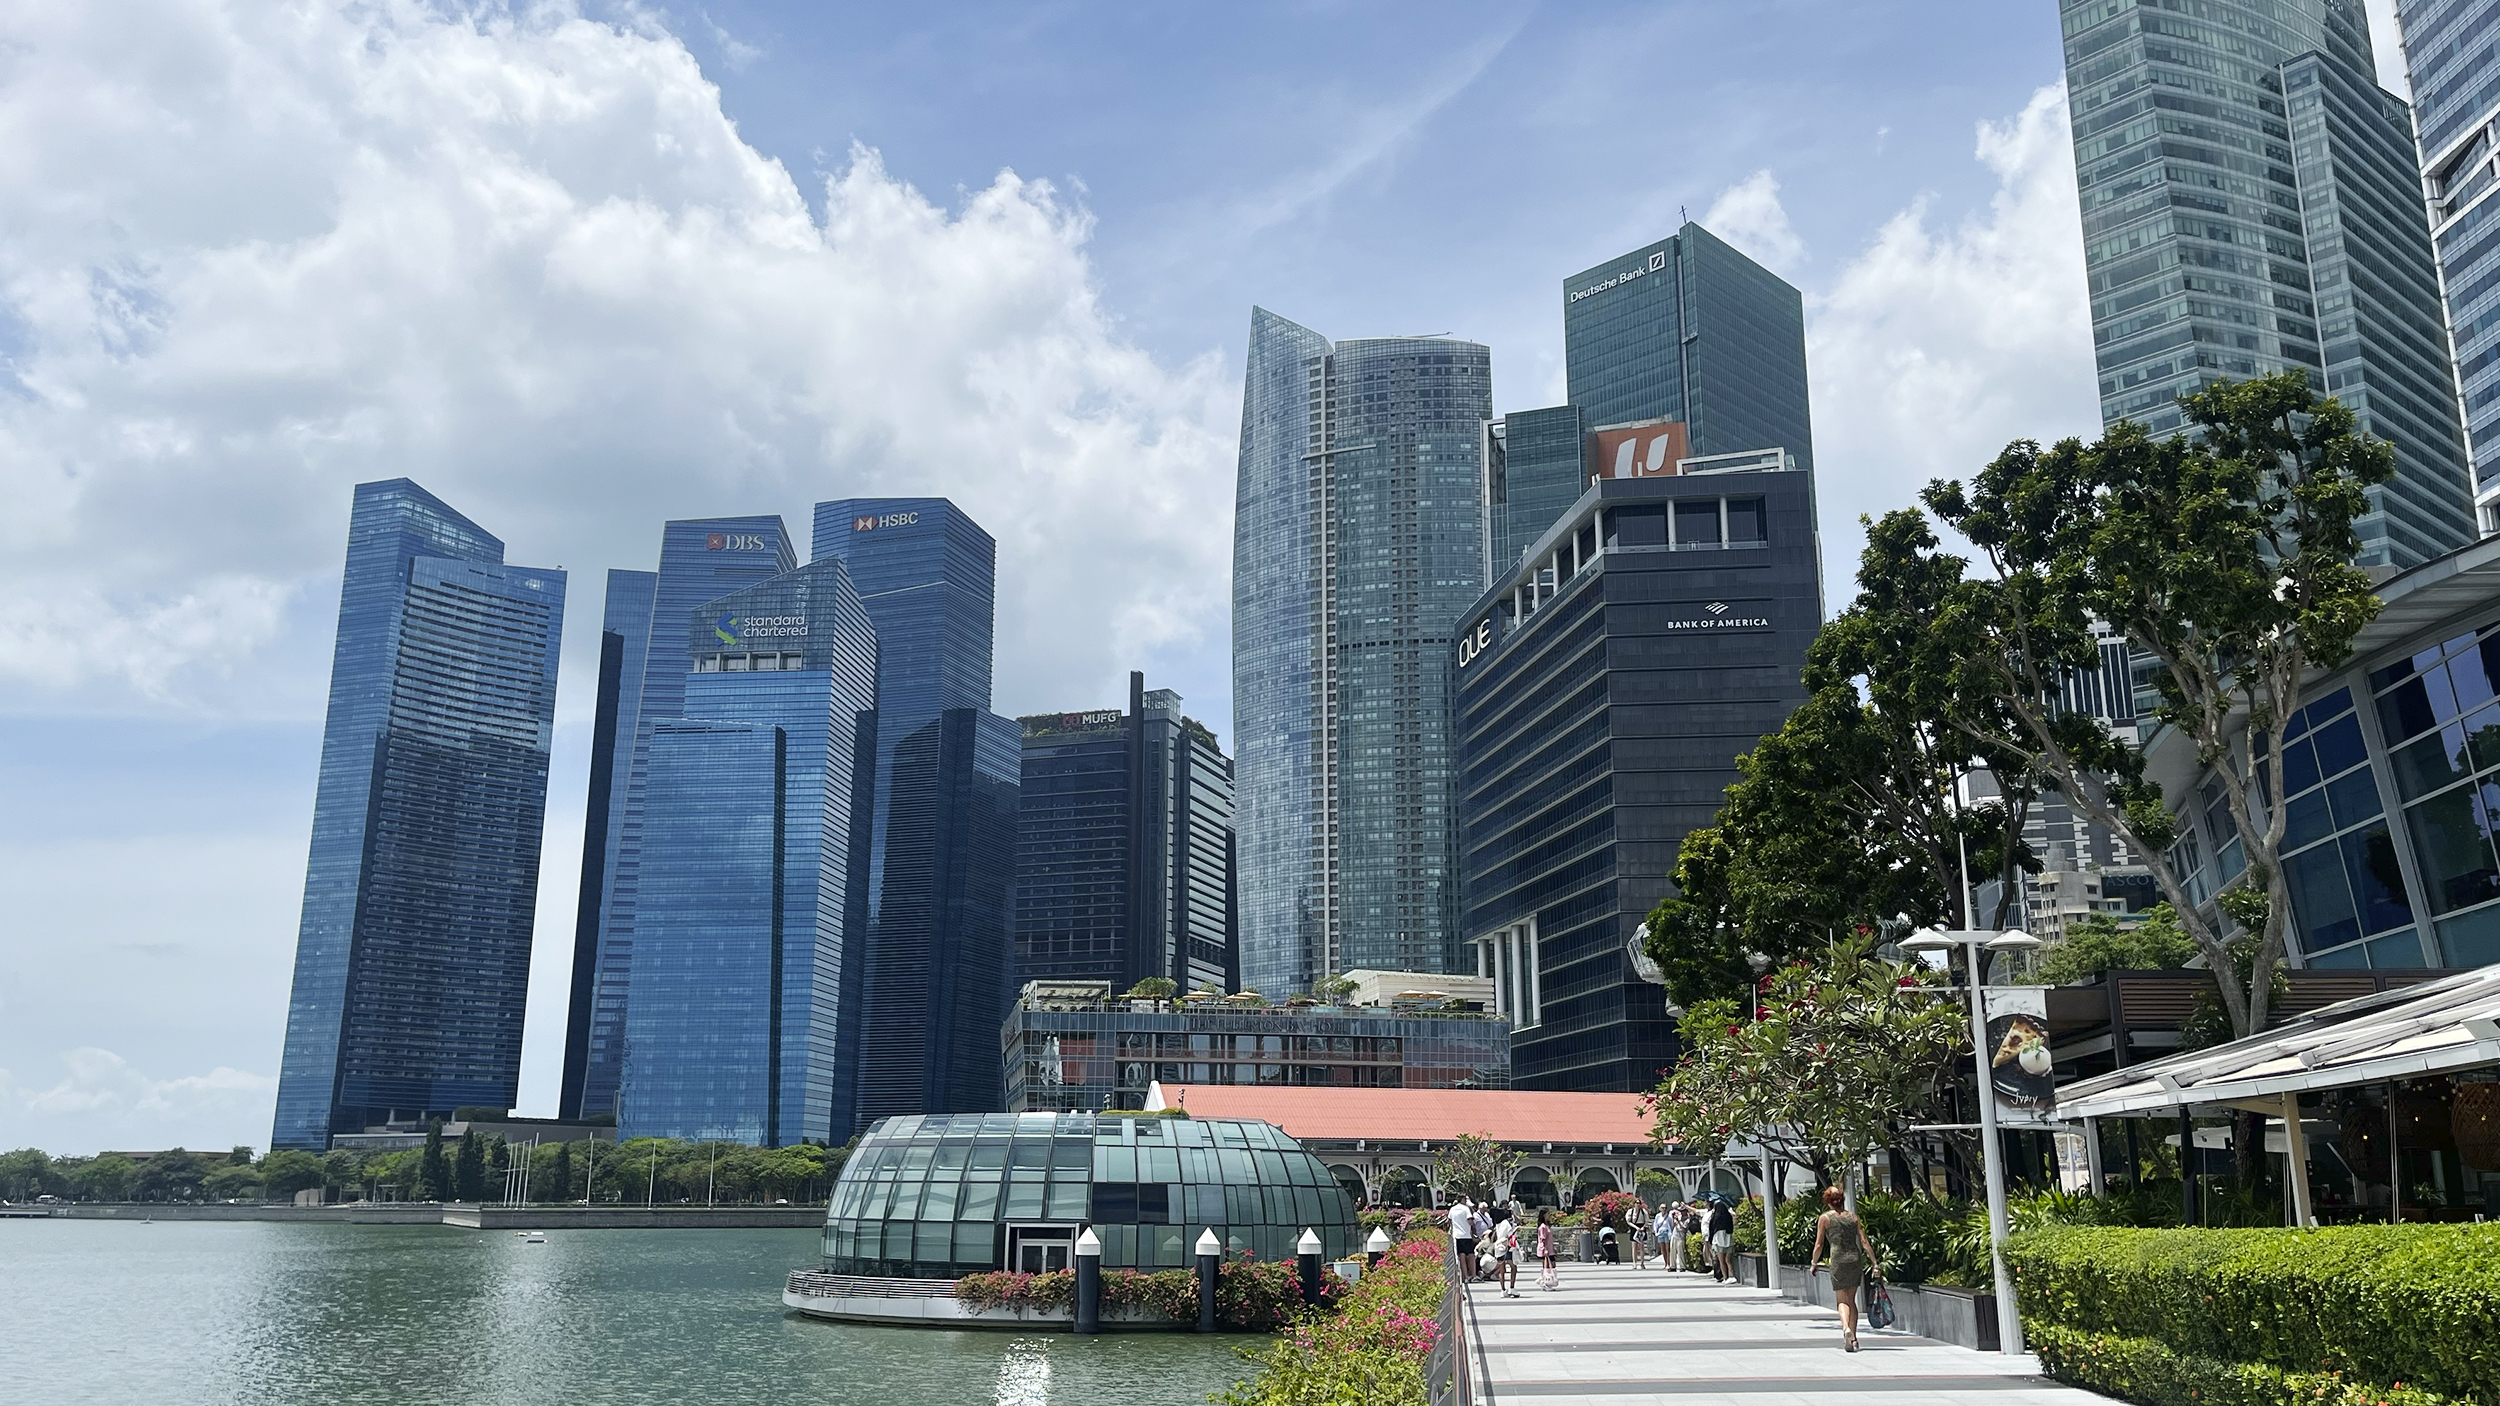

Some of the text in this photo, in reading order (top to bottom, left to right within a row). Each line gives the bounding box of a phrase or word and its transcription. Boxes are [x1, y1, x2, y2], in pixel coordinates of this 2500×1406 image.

[1570, 266, 1646, 303] Deutsche Bank
[878, 511, 919, 528] HSBC
[725, 534, 765, 550] DBS
[744, 614, 805, 627] standard
[1667, 618, 1769, 629] BANK OF AMERICA
[743, 625, 808, 637] chartered
[1458, 618, 1491, 668] OUE
[1082, 711, 1118, 725] MUFG
